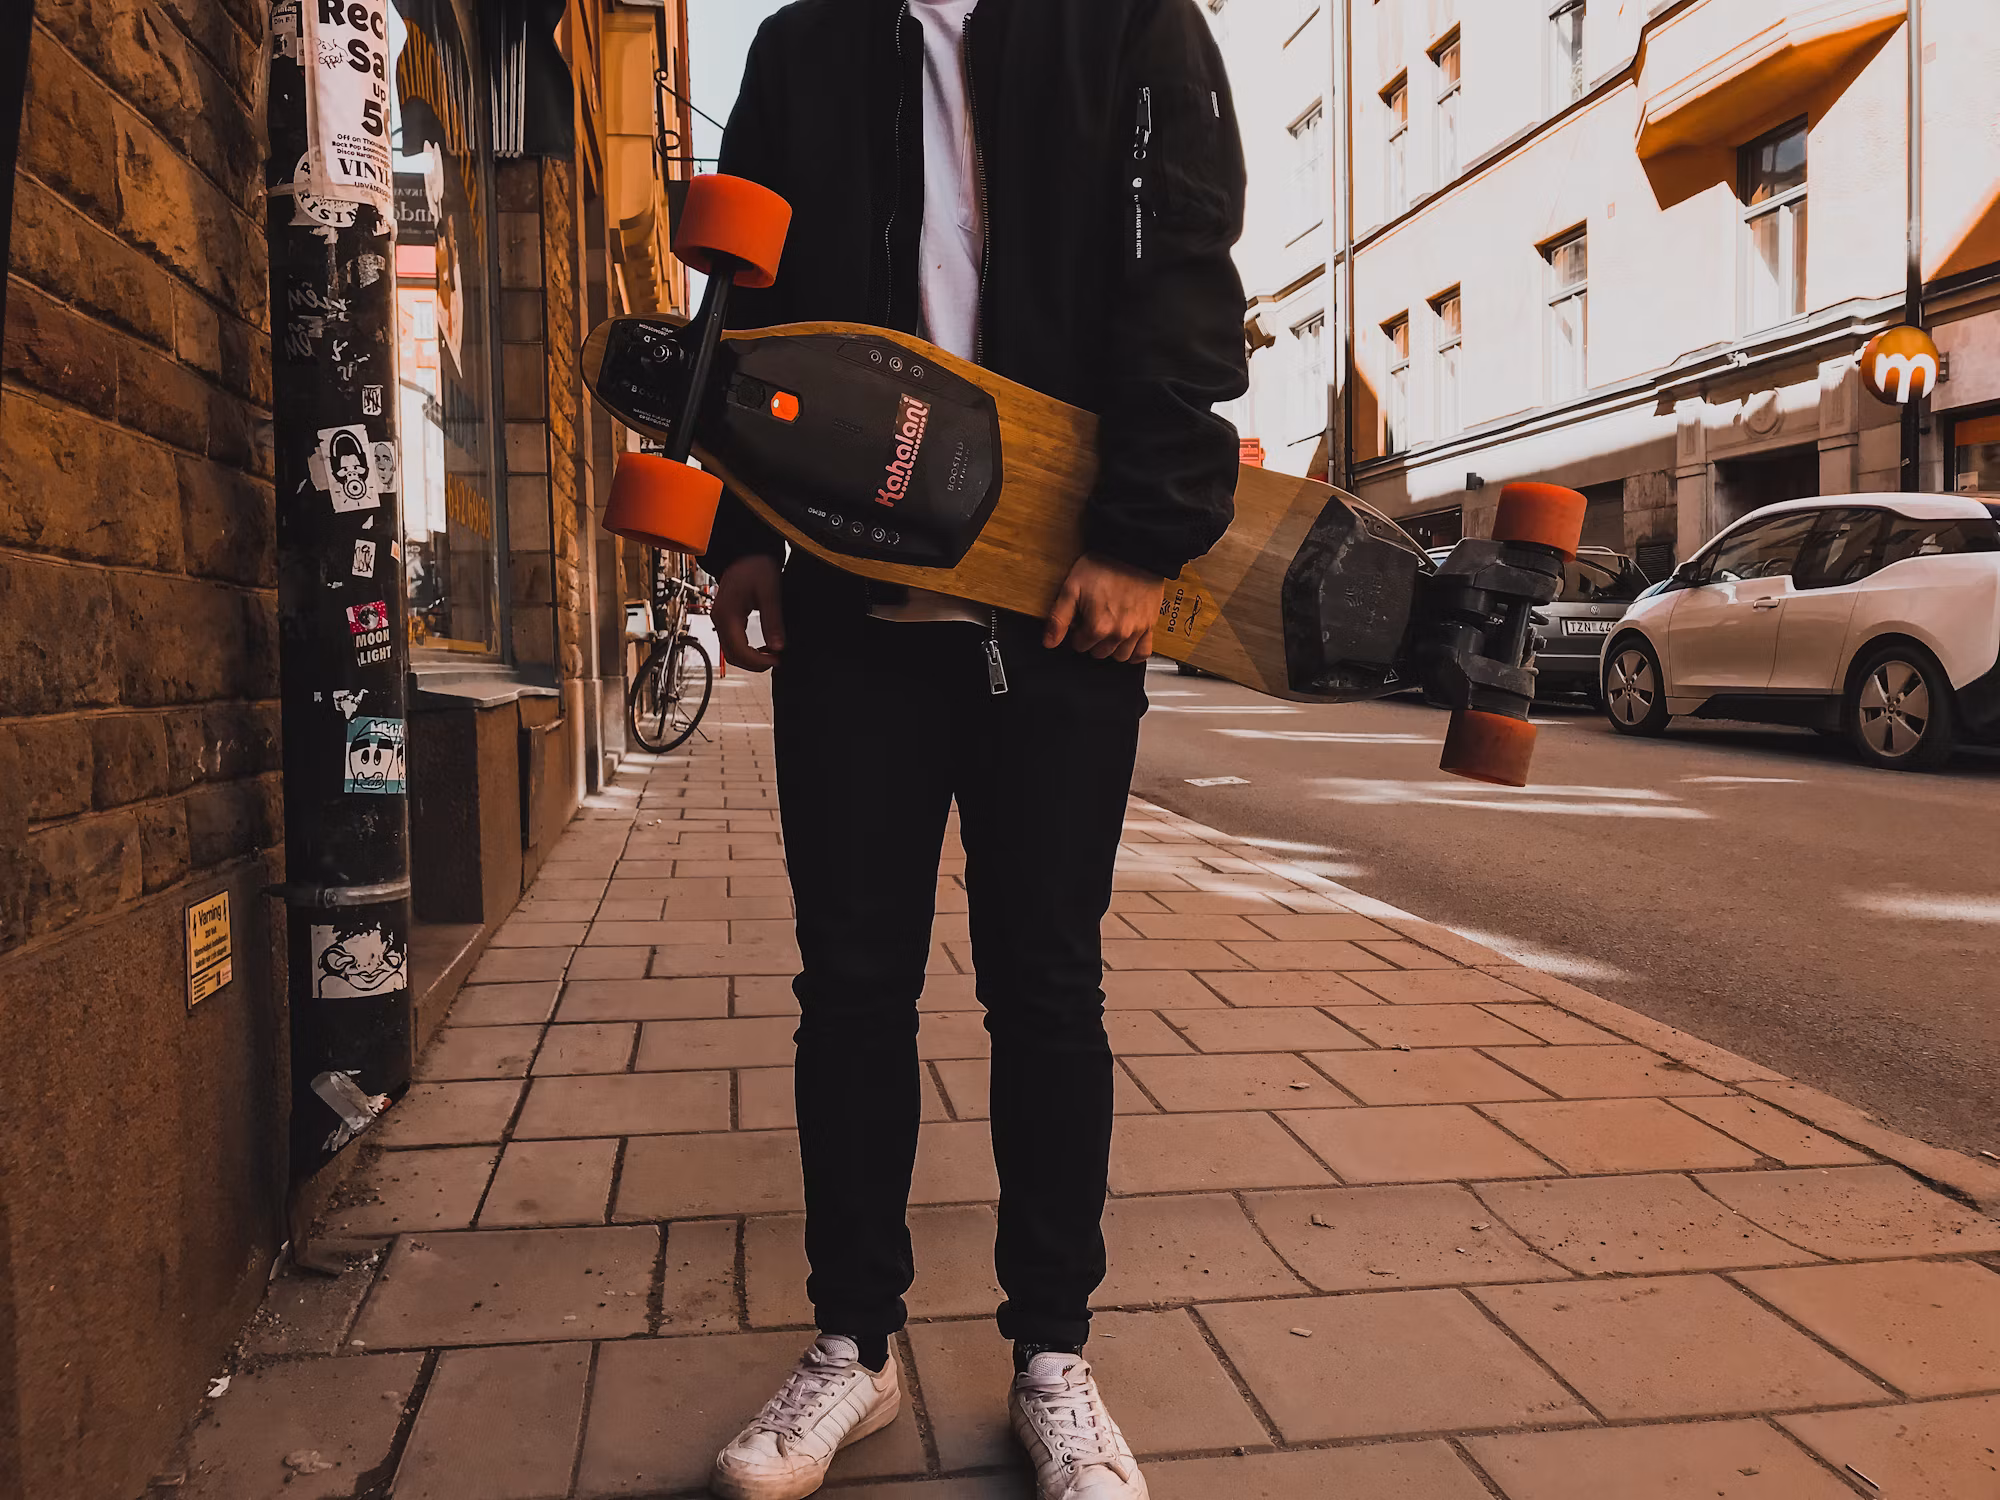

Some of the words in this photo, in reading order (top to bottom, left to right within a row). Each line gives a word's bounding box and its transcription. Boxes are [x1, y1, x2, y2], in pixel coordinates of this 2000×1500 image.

[317, 0, 387, 41] Rec
[347, 38, 387, 82] Sa
[372, 82, 387, 104] up
[331, 140, 348, 148] Rock
[349, 143, 362, 151] Pop
[336, 133, 350, 141] Off
[336, 148, 355, 156] Disco
[337, 157, 391, 189] VINYL
[947, 441, 965, 492] BOOSTED
[1167, 588, 1185, 633] BOOSTED
[1569, 622, 1591, 632] TZN
[355, 628, 390, 649] MOON
[359, 645, 392, 665] LIGHT
[198, 904, 222, 927] Varning
